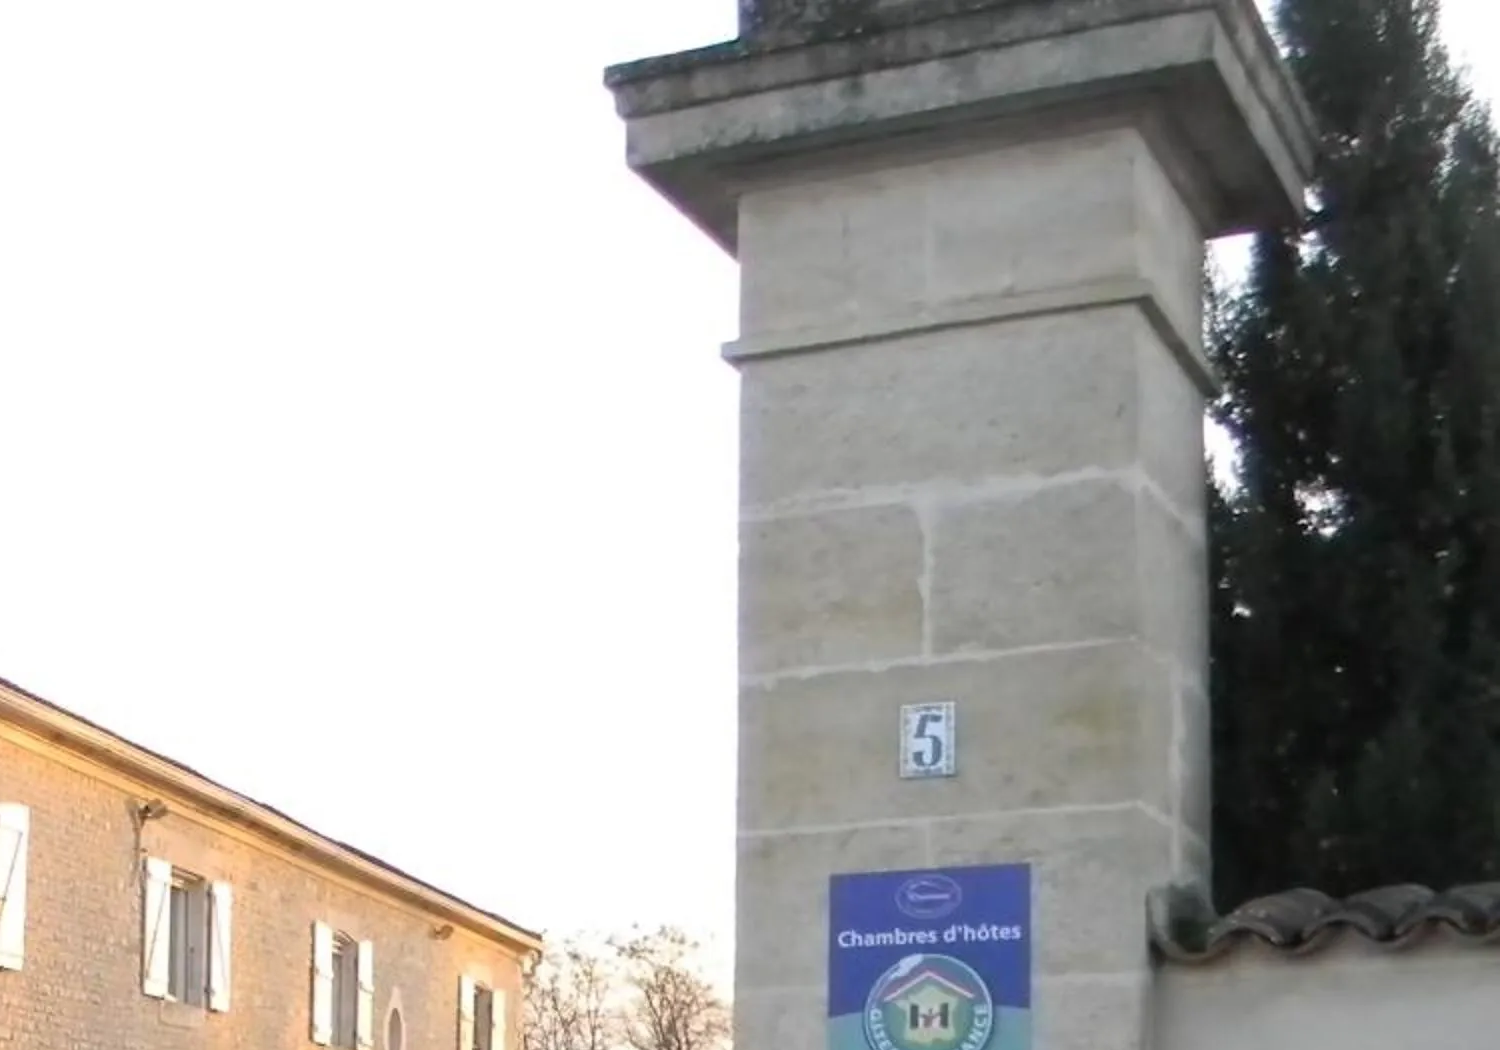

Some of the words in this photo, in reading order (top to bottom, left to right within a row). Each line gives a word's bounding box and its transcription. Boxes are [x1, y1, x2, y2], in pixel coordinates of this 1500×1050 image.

[911, 713, 943, 767] 5
[837, 927, 938, 948] Chambres
[943, 922, 1022, 944] d'hôtes
